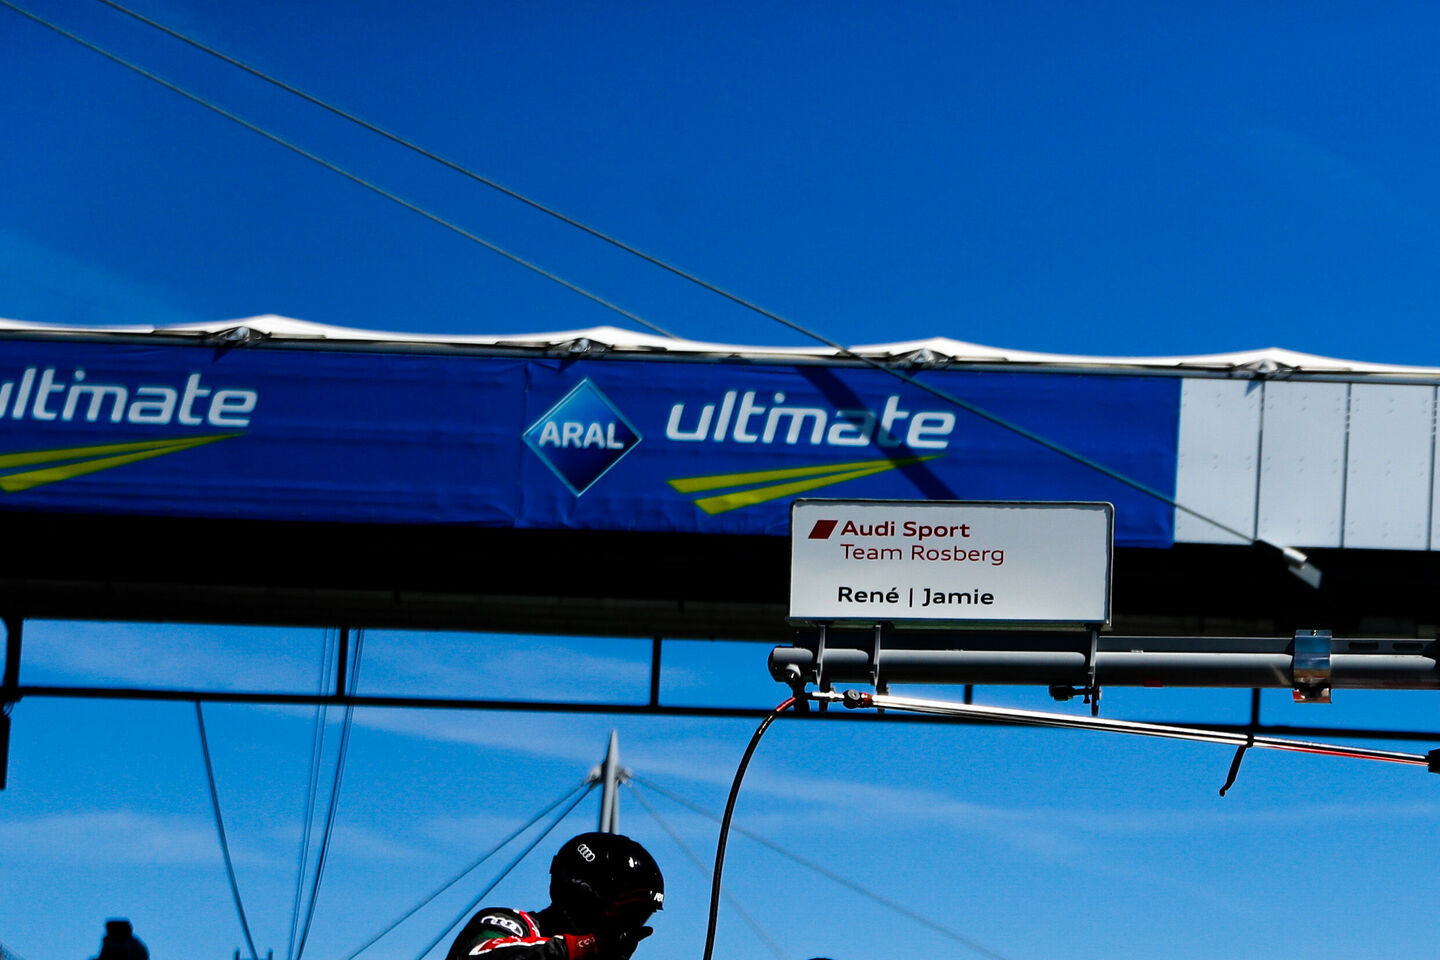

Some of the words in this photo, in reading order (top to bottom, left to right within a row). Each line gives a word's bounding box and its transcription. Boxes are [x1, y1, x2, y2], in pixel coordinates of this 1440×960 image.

[666, 390, 957, 450] ultimate
[538, 420, 625, 450] ARAL
[840, 520, 896, 537] Audi
[902, 521, 971, 541] Sport
[840, 543, 903, 560] Team
[911, 544, 1005, 566] Rosberg
[837, 586, 900, 603] René
[921, 587, 995, 607] Jamie
